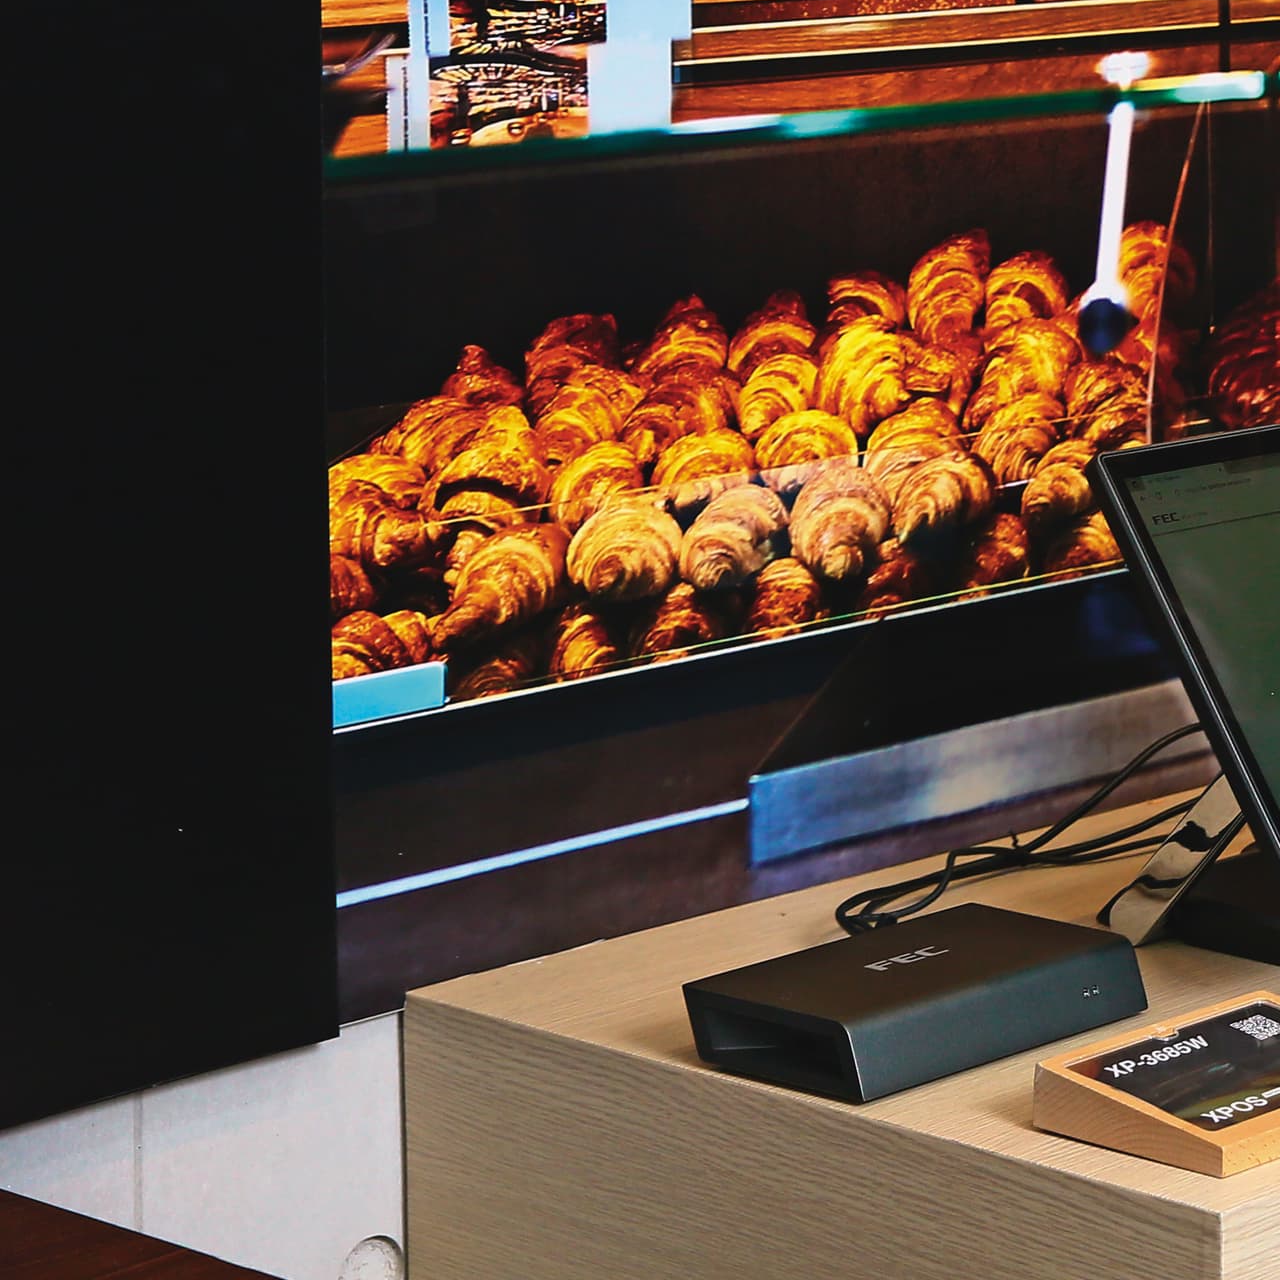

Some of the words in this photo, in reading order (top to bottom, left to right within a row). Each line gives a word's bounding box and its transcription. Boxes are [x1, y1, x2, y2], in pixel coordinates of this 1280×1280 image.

[1152, 512, 1181, 526] FEC
[864, 946, 949, 971] FEC
[1103, 1035, 1209, 1078] XP-3685W
[1201, 1095, 1269, 1124] XPOS
